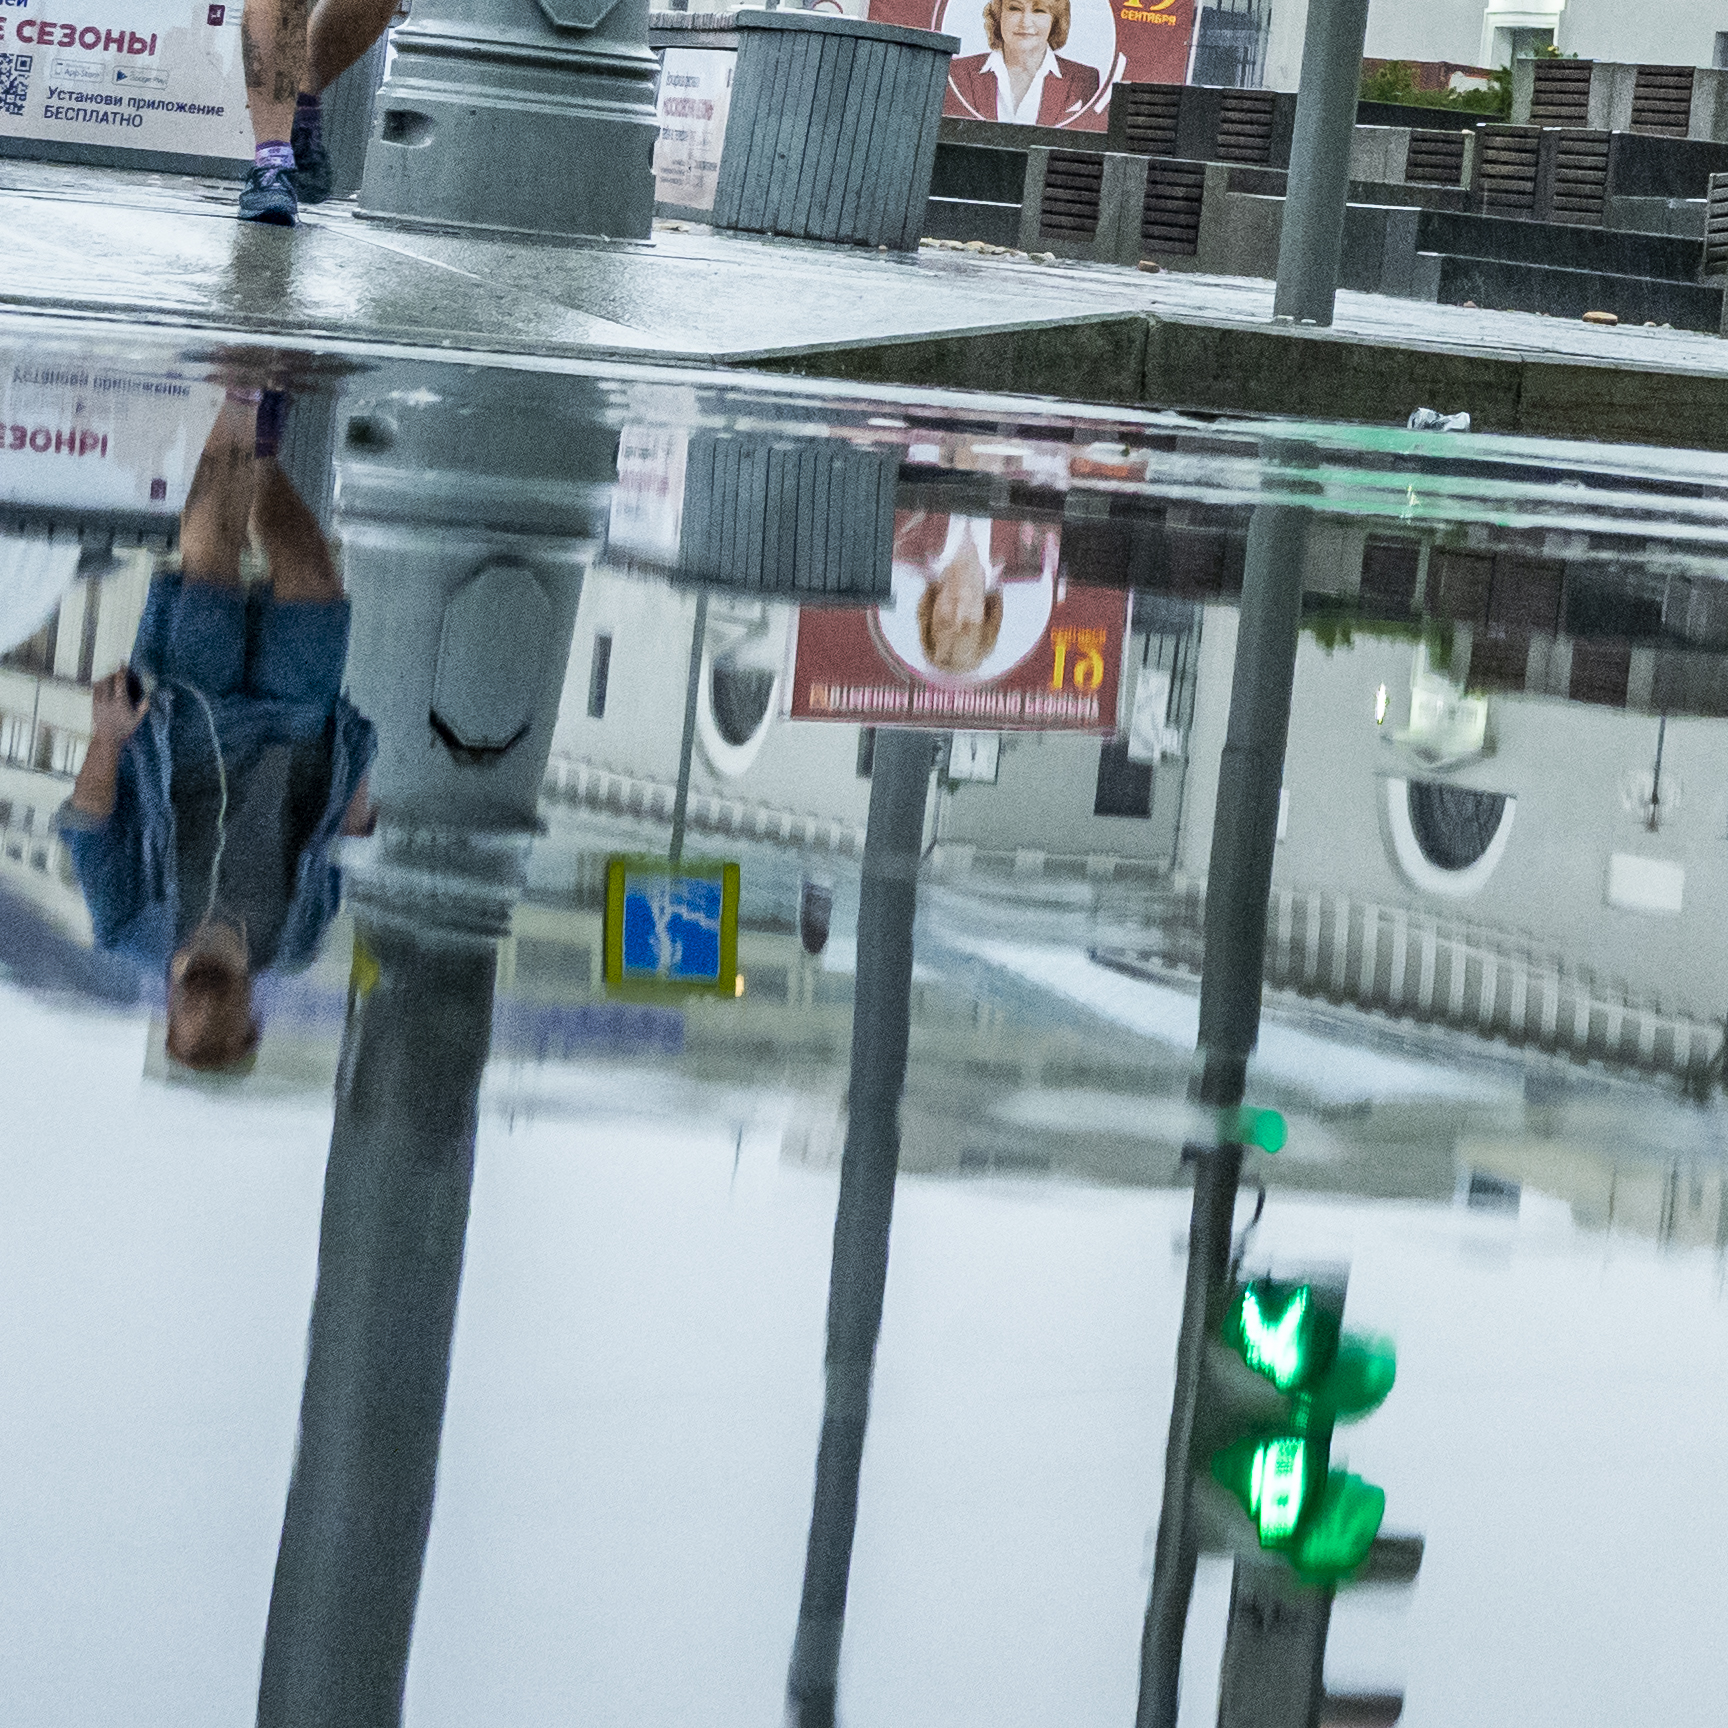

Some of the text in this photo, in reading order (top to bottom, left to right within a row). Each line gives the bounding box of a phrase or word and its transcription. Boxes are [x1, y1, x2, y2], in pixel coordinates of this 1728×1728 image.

[1120, 9, 1177, 26] СЕНТЯБРЯ
[16, 19, 157, 56] СЕЗОНЫ
[47, 86, 225, 117] Установи приложение
[44, 105, 143, 128] БЕСПЛАТНО
